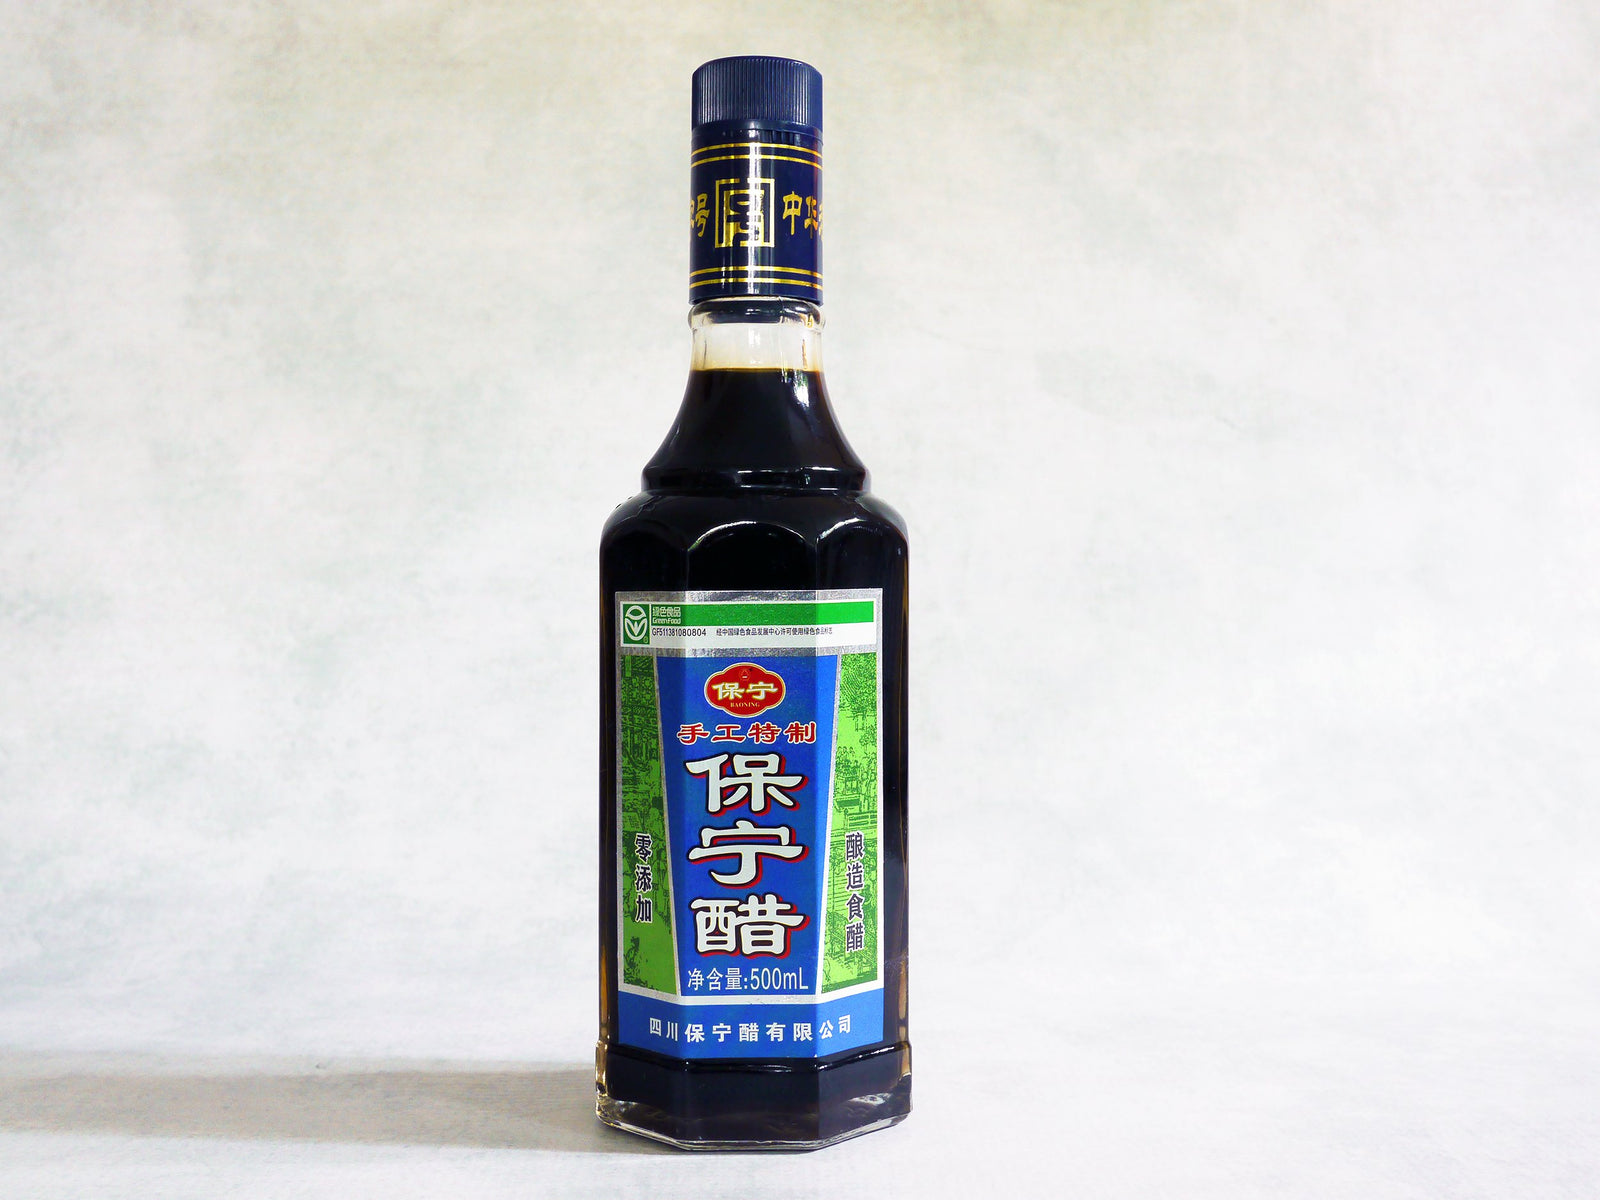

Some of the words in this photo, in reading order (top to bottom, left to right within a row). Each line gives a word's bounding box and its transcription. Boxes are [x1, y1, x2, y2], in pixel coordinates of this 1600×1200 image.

[652, 628, 707, 637] GF511381080804
[712, 682, 778, 700] 保宁
[677, 722, 817, 745] 手工特制
[685, 752, 810, 959] 保宁醋
[635, 833, 652, 923] 零添加
[845, 831, 865, 952] 酿造食醋
[649, 1014, 851, 1042] 四川保宁醋有限公司
